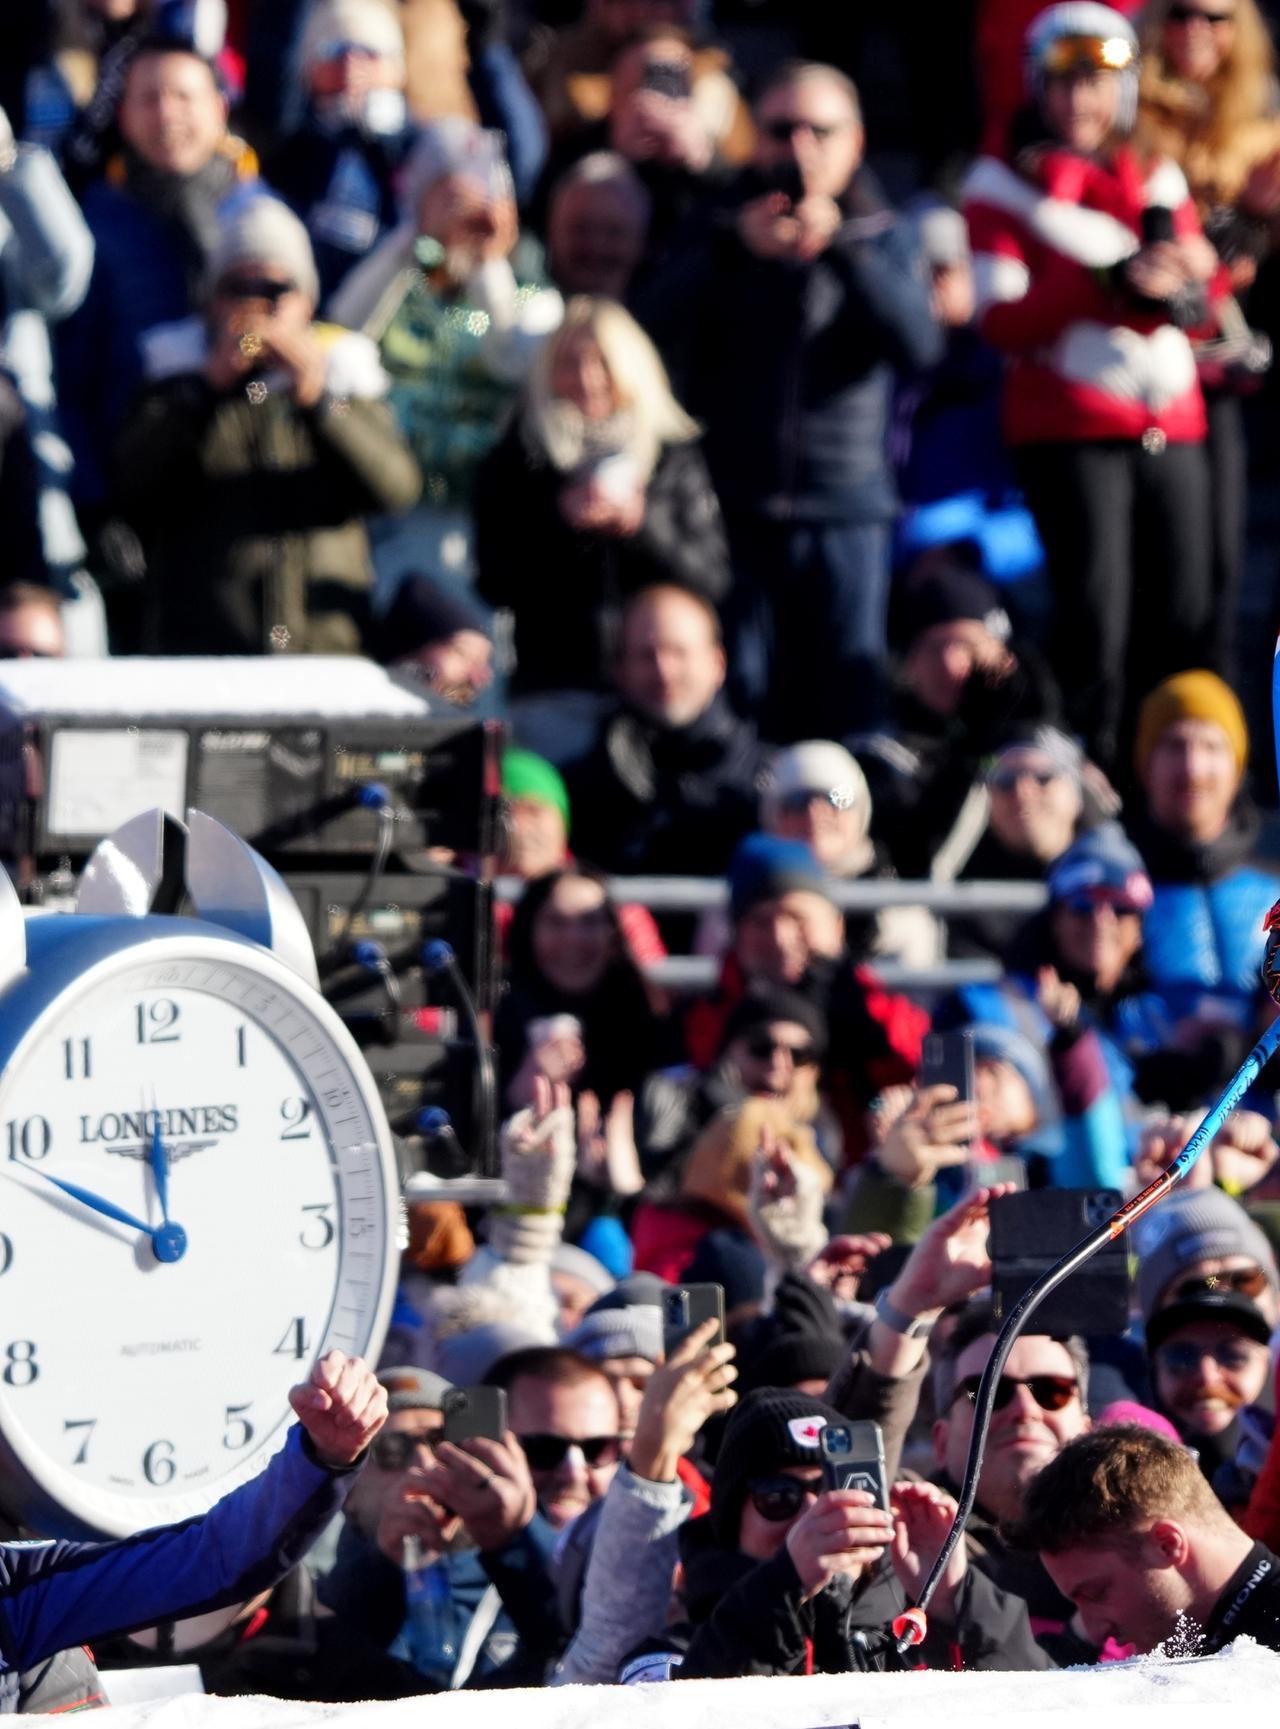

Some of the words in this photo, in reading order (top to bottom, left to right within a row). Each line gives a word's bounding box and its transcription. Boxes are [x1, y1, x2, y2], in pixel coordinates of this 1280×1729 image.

[134, 998, 182, 1044] 12
[62, 1037, 92, 1080] 11
[236, 1024, 247, 1068] 1
[5, 1115, 52, 1161] 10
[79, 1104, 239, 1143] LONGINES
[280, 1097, 312, 1140] 2
[300, 1203, 334, 1250] 3
[272, 1317, 311, 1359] 4
[3, 1341, 40, 1388] 8
[63, 1418, 98, 1465] 7
[222, 1402, 256, 1450] 5
[143, 1439, 176, 1486] 6
